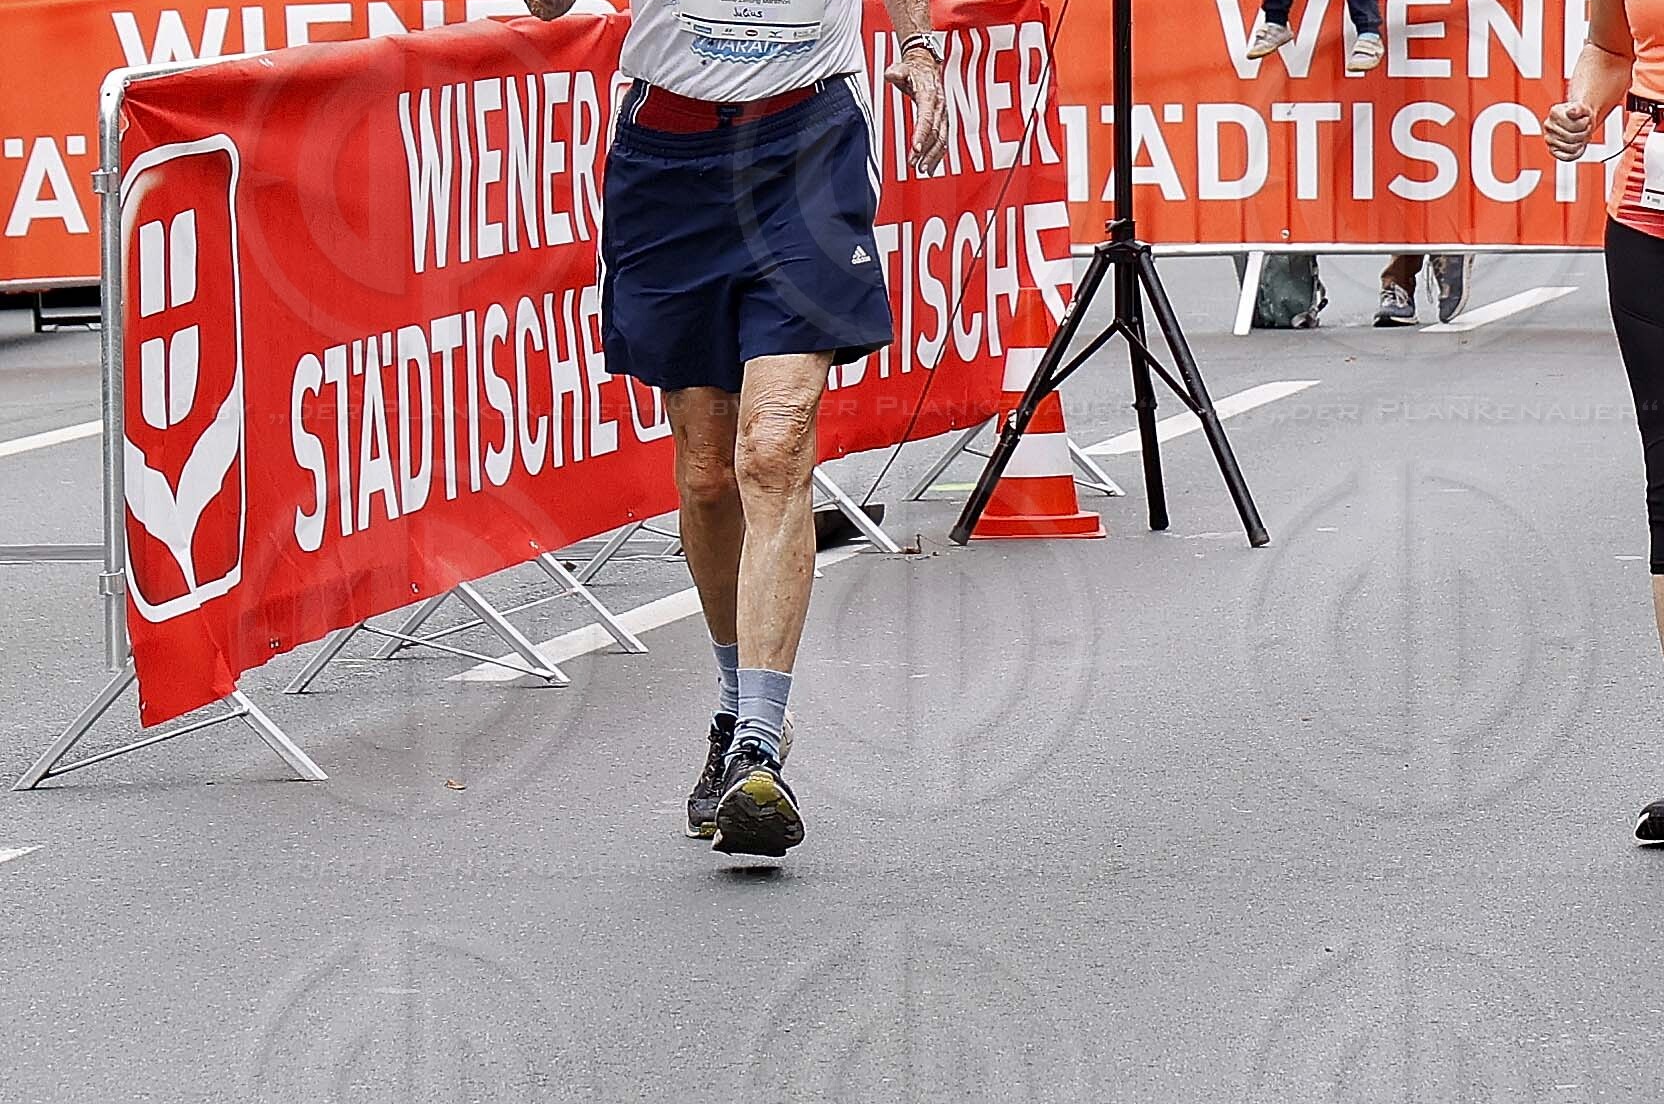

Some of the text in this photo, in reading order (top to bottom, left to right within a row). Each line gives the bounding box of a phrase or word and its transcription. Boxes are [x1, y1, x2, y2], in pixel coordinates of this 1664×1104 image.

[733, 5, 764, 18] Julius
[399, 71, 603, 274] WIENER
[290, 287, 620, 553] STÄDTISCHE
